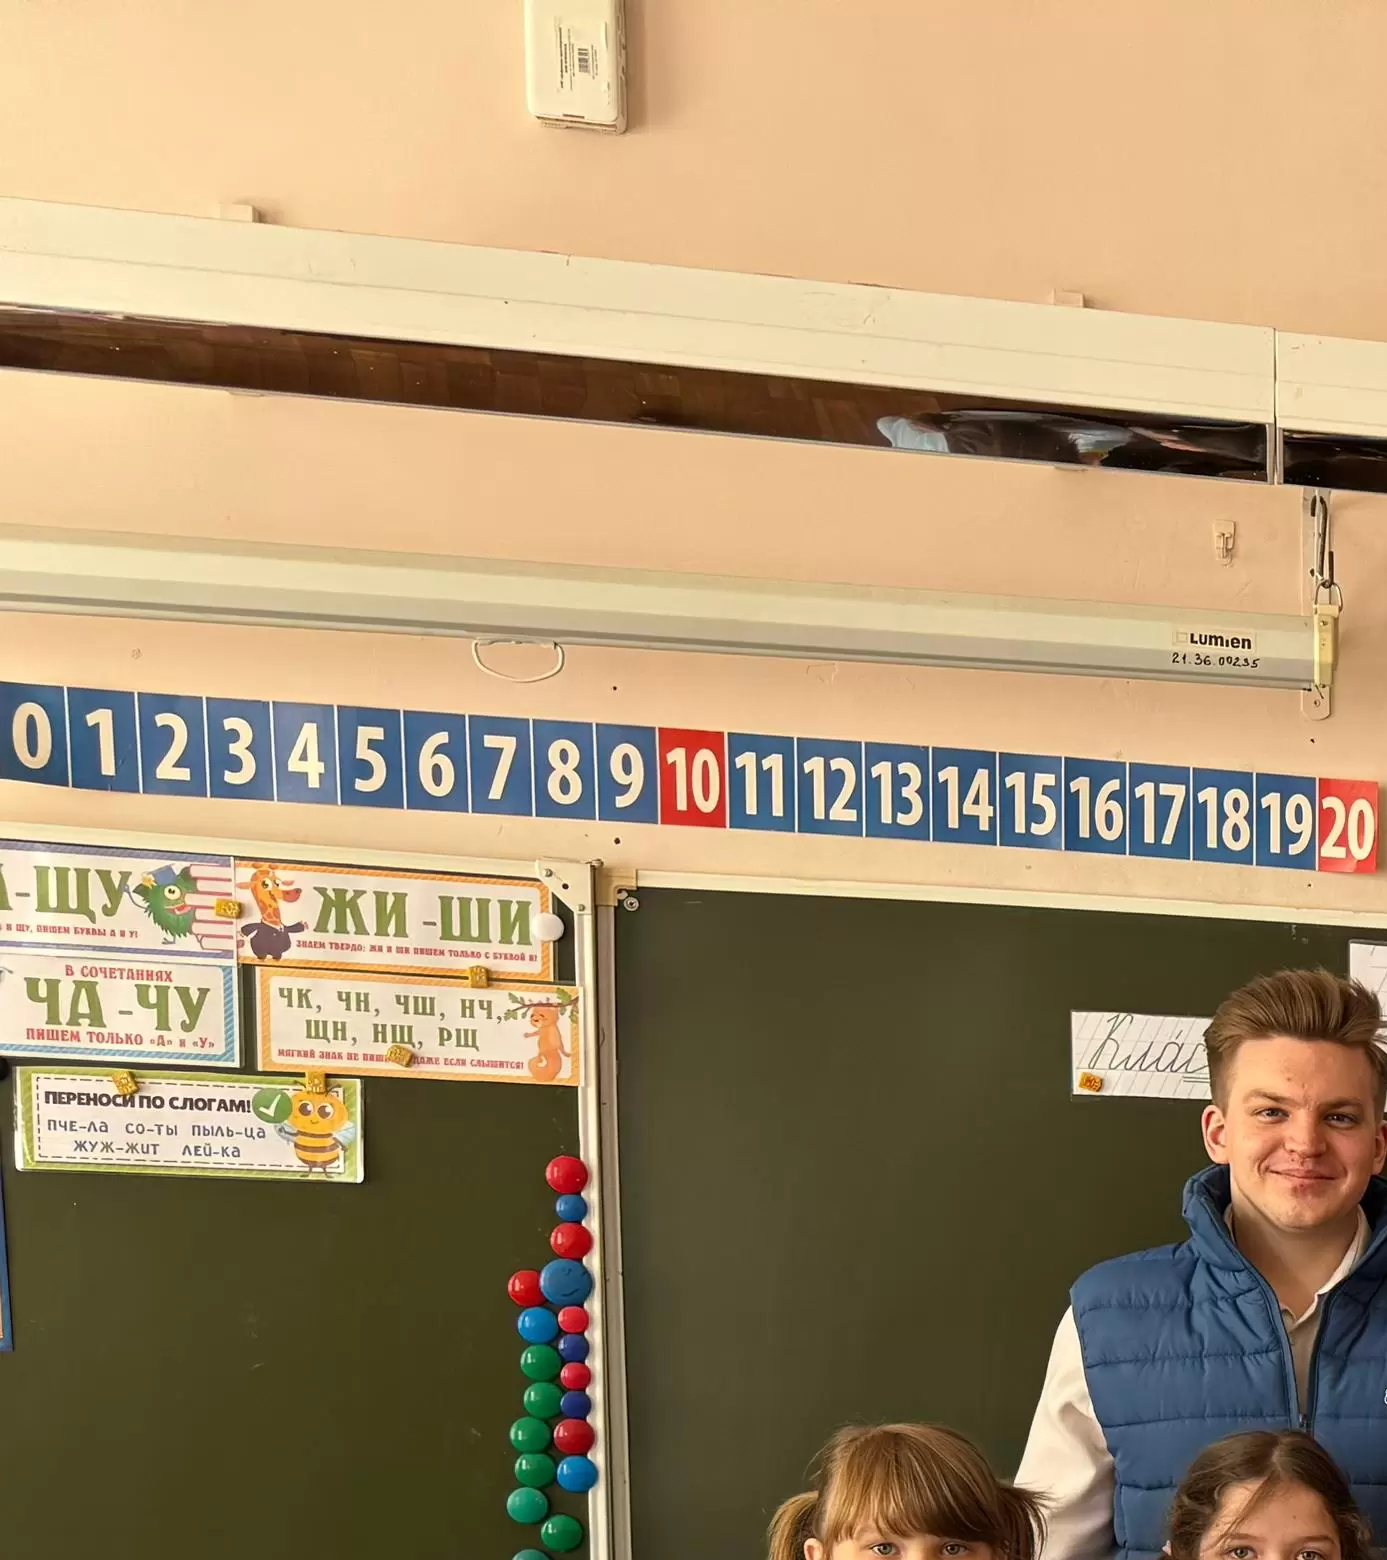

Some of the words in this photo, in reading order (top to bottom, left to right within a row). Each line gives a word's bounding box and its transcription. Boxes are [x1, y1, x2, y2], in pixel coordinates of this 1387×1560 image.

[1190, 632, 1252, 650] Lumien
[12, 702, 52, 769] 0
[86, 708, 116, 776] 1
[155, 713, 191, 781] 2
[223, 717, 256, 785] 3
[287, 722, 325, 789] 4
[354, 726, 387, 792] 5
[418, 731, 455, 797] 6
[483, 735, 517, 800] 7
[546, 739, 582, 805] 8
[609, 742, 644, 808] 9
[666, 748, 720, 813] 10
[734, 752, 786, 818] 11
[803, 756, 857, 821] 12
[871, 761, 923, 826] 13
[937, 766, 994, 832] 14
[1004, 771, 1057, 836] 15
[1070, 776, 1124, 841] 16
[1134, 781, 1186, 845] 17
[1197, 787, 1251, 851] 18
[1260, 792, 1313, 856] 19
[1320, 797, 1374, 860] 20
[65, 964, 75, 977] В
[80, 965, 173, 983] СОЧЕТАНИЯХ
[26, 1027, 81, 1043] ПИШЕМ
[86, 1031, 144, 1046] ТОЛЬКО
[44, 1091, 136, 1108] ПЕРЕНОСИ
[138, 1095, 165, 1110] ПО
[169, 1096, 251, 1113] СЛОГАМ!
